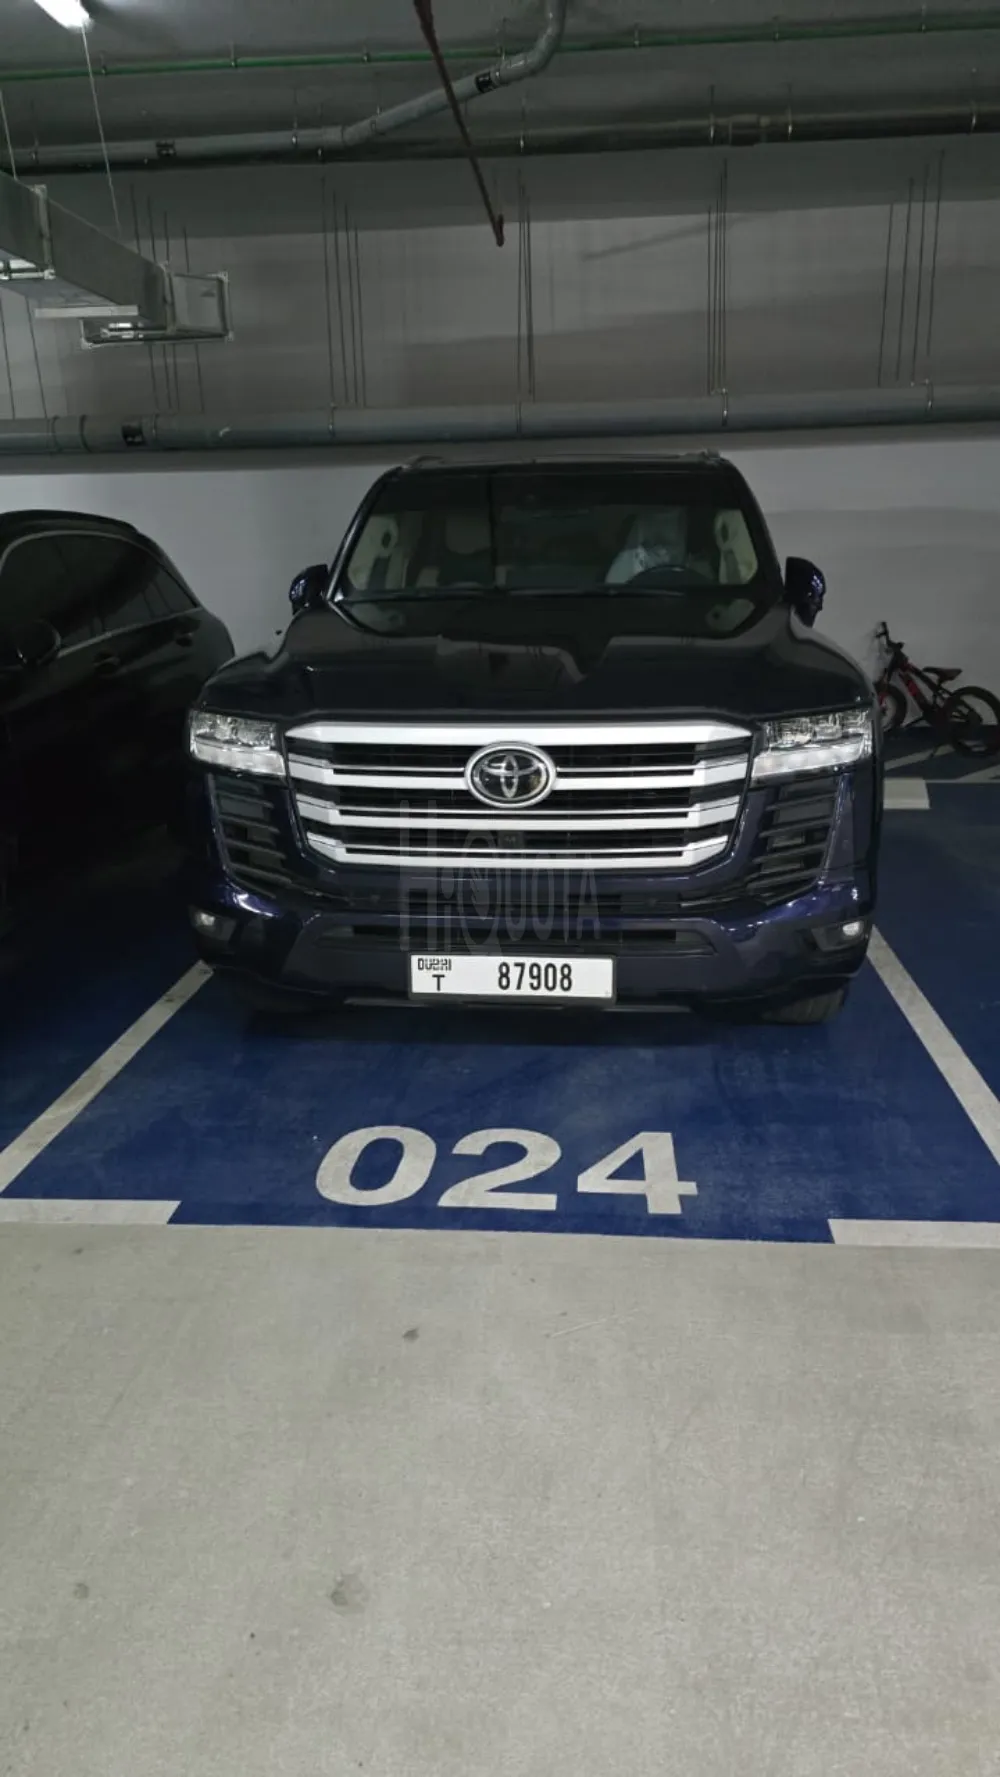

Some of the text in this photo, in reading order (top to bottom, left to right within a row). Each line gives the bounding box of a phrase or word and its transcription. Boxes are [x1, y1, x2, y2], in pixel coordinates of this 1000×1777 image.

[432, 962, 572, 992] T 87908
[316, 1125, 698, 1215] 024
